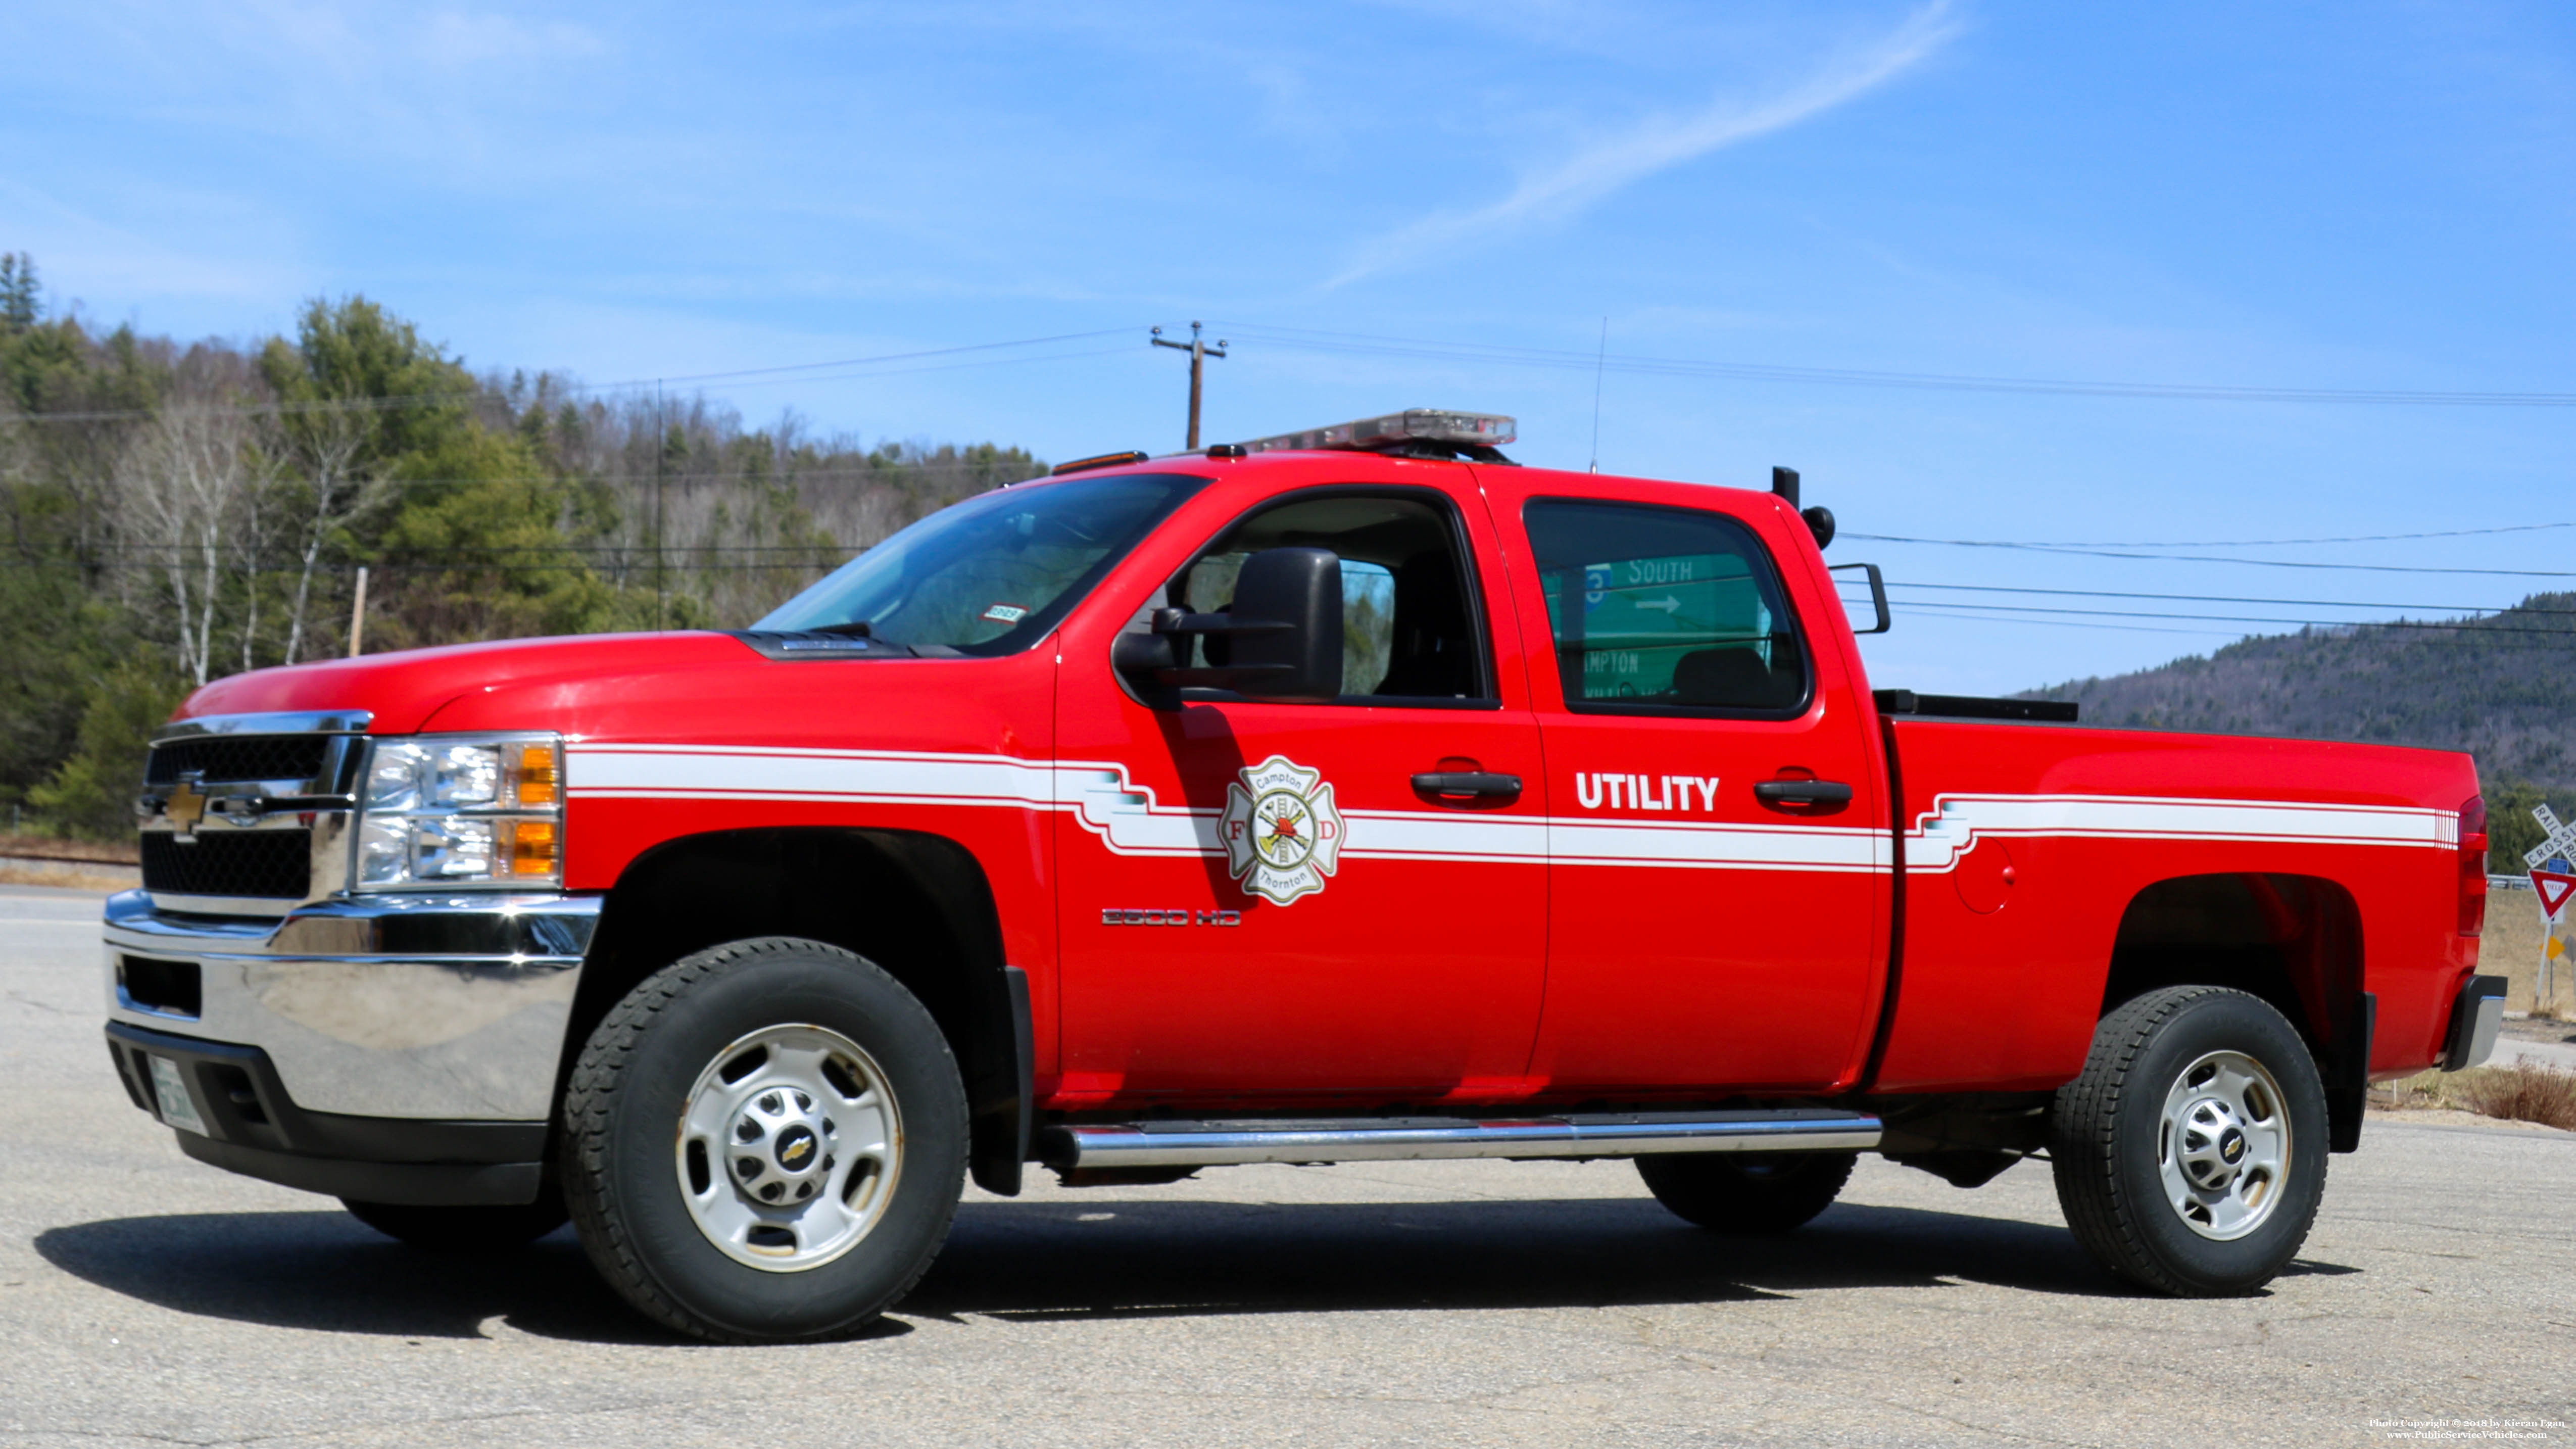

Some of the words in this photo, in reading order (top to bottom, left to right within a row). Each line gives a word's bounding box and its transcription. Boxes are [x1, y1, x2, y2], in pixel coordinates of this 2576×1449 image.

[1628, 559, 1692, 583] SOUTH
[1256, 772, 1302, 789] Campton
[1576, 772, 1719, 811] UTILITY
[1229, 820, 1246, 840] F
[1320, 820, 1336, 840] D
[2535, 807, 2558, 835] RAIL
[2528, 824, 2576, 863] CROSSI
[1262, 871, 1307, 888] Thornton
[1102, 909, 1188, 926] 2500
[1196, 909, 1241, 926] HD
